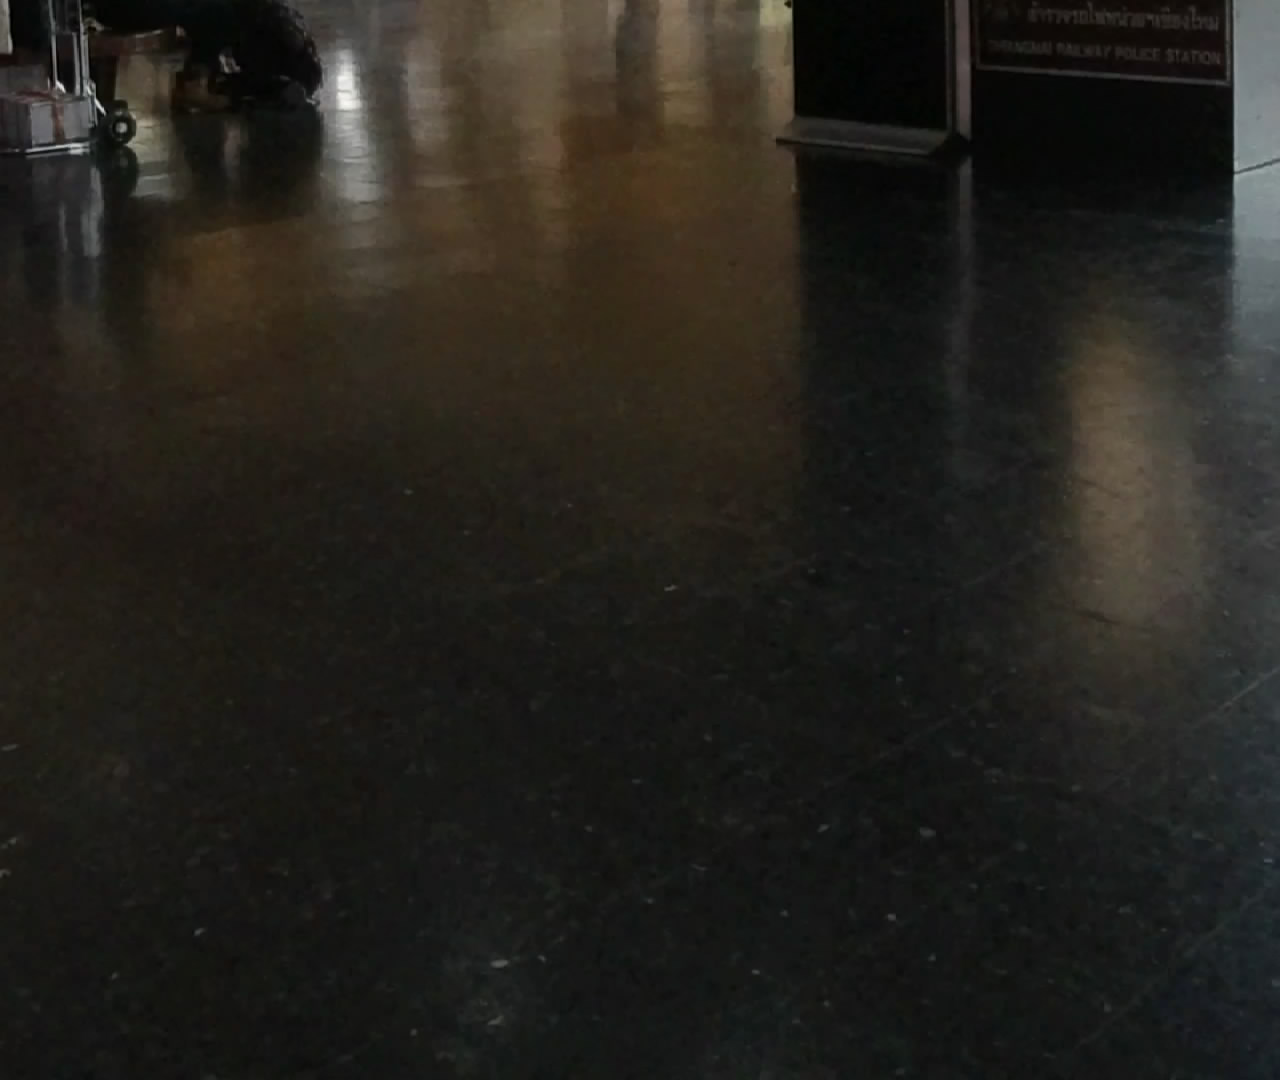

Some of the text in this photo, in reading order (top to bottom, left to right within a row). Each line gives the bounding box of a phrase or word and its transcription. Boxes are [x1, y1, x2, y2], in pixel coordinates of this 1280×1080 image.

[1056, 42, 1112, 60] RAILWAY
[1114, 44, 1161, 62] POLICE
[1164, 47, 1222, 65] STATION
